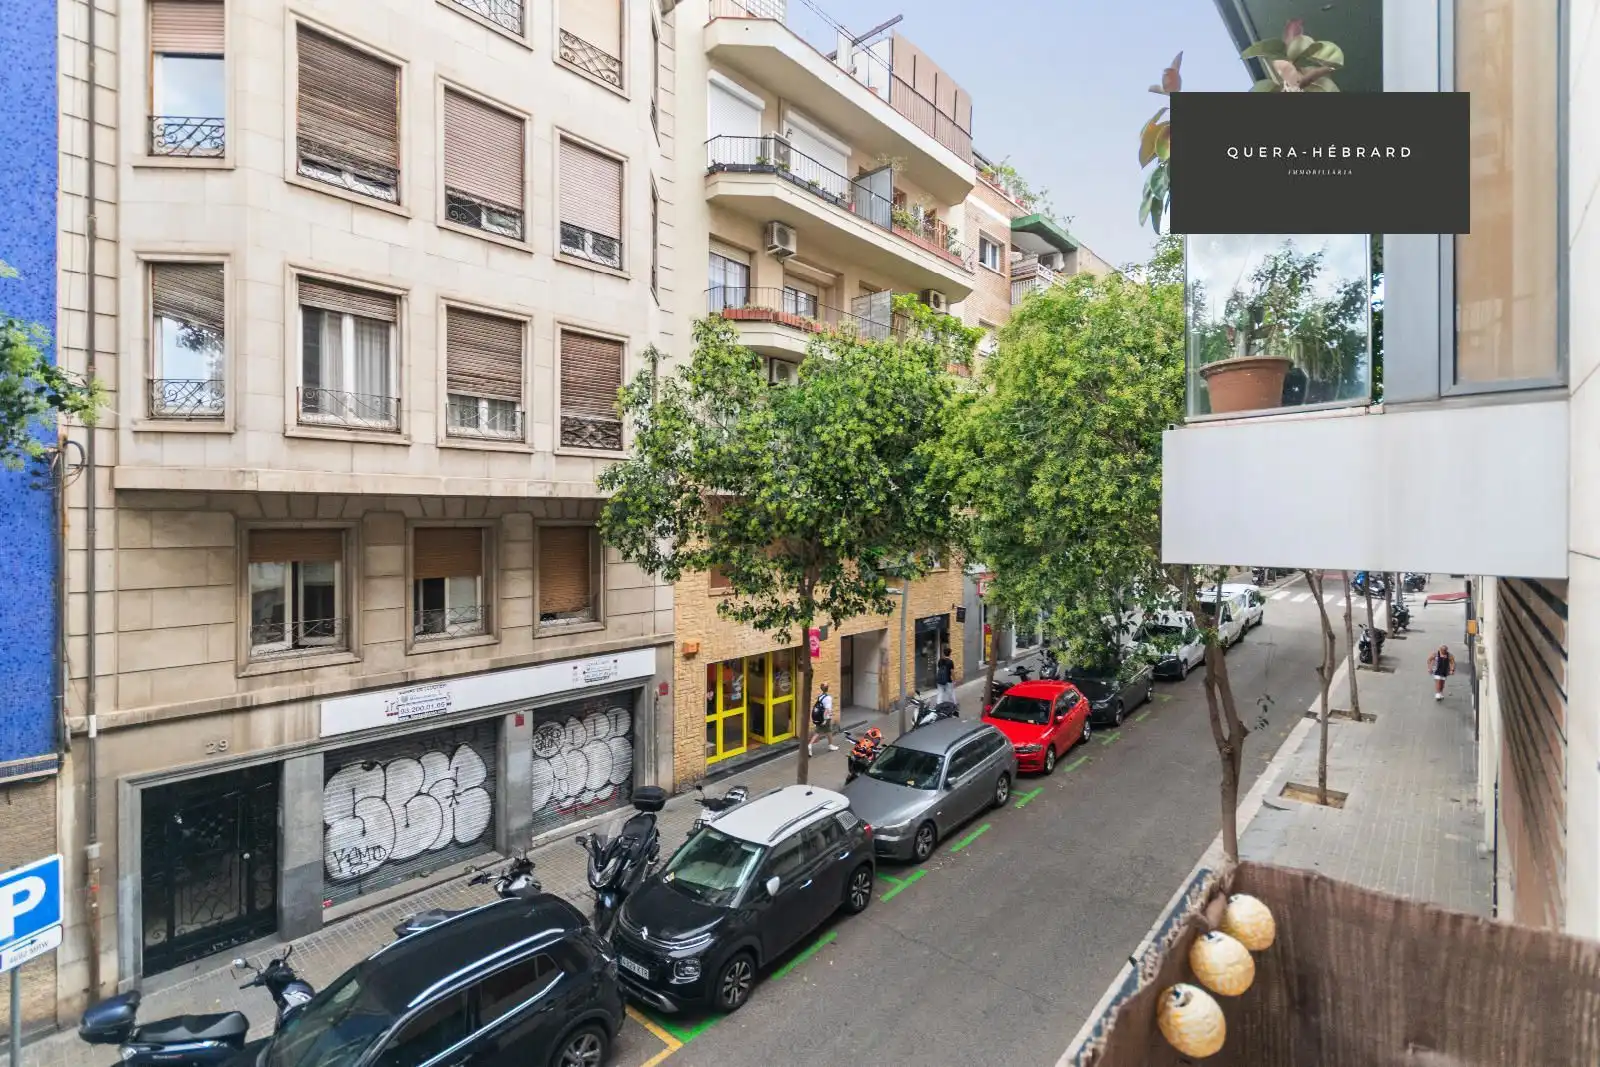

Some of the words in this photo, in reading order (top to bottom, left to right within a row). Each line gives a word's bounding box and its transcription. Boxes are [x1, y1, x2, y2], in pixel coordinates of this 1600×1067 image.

[400, 703, 446, 714] 93.200.01.05
[206, 739, 229, 755] 29
[0, 876, 46, 940] P
